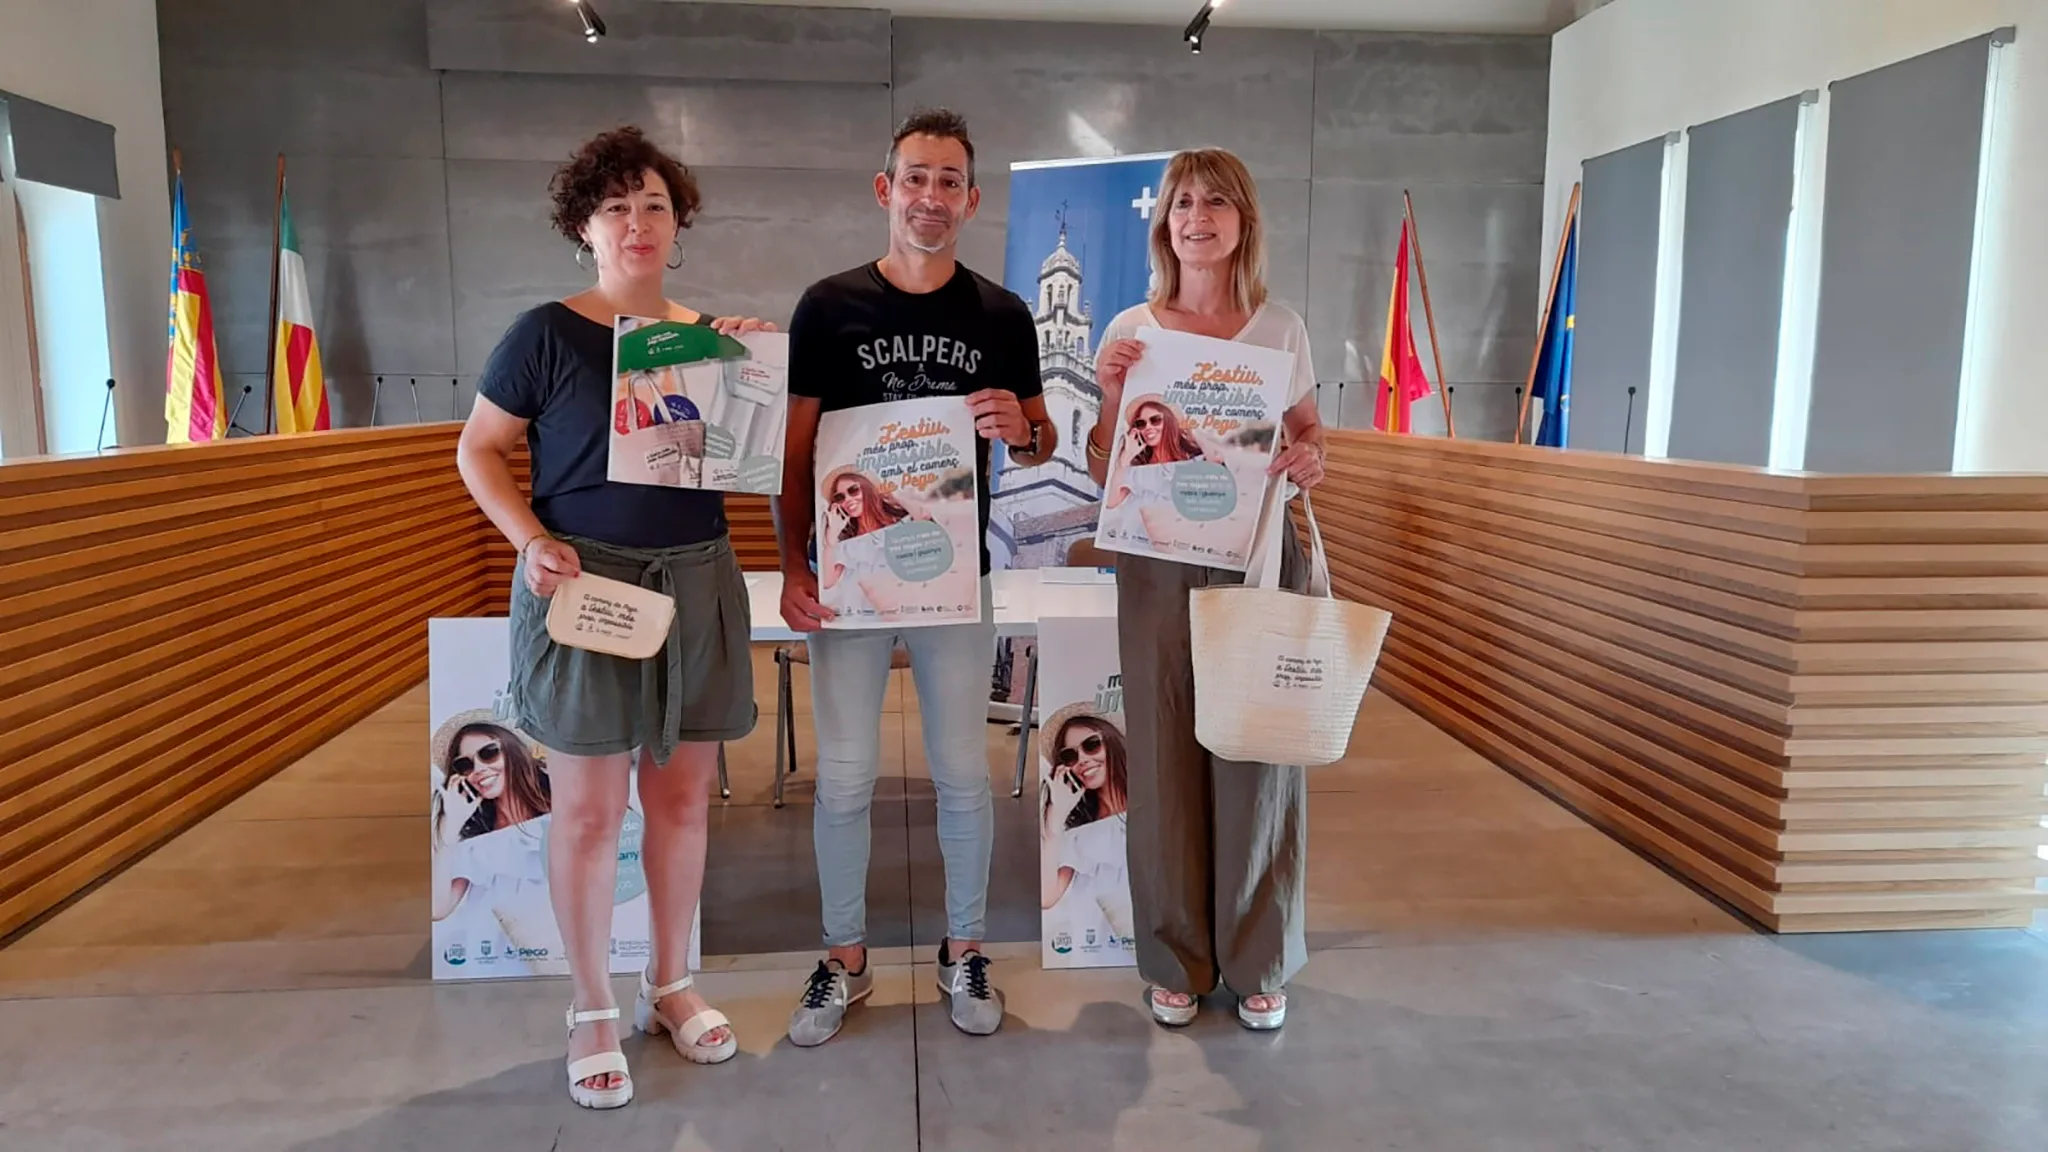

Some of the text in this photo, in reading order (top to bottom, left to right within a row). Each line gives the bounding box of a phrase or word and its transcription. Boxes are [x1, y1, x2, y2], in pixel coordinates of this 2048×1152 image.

[857, 335, 982, 374] SCALPERS
[882, 371, 958, 392] No Drama
[1185, 405, 1208, 416] amb
[1211, 405, 1222, 416] el
[880, 465, 904, 478] amb
[907, 460, 919, 473] el
